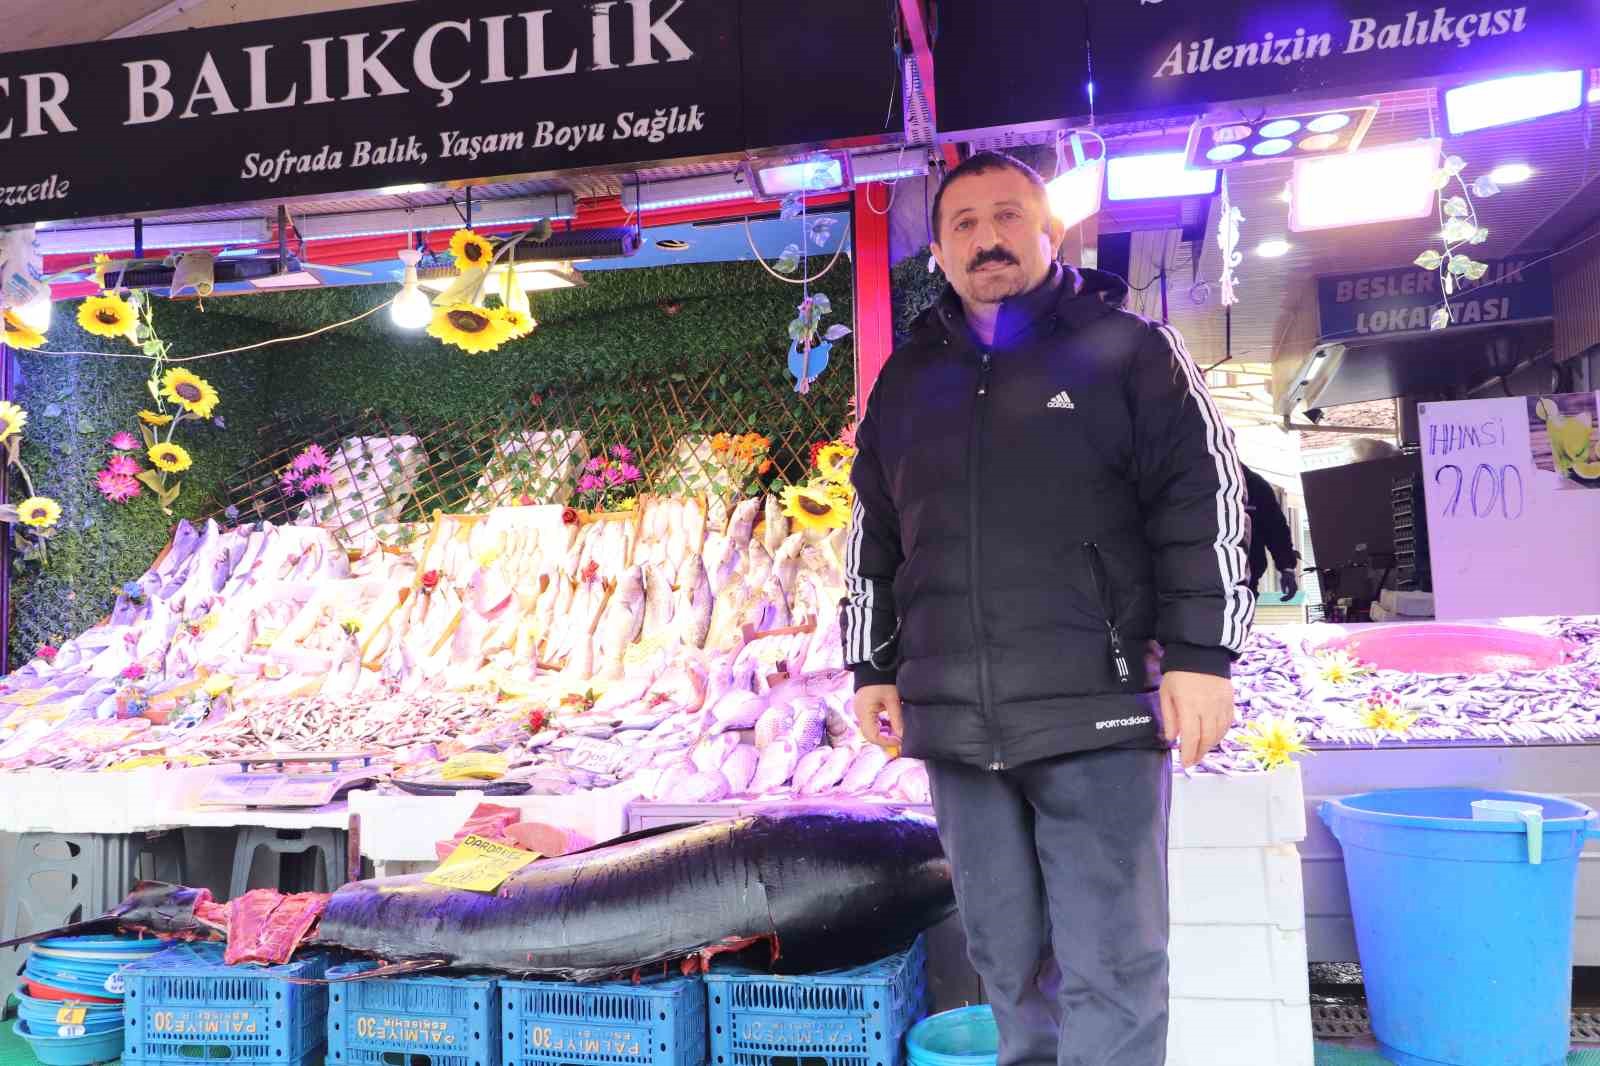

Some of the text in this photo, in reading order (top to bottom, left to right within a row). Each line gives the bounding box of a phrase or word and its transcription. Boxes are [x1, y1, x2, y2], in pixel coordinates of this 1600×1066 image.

[1152, 6, 1527, 79] Ailenizin Balıkçısı
[0, 71, 78, 139] R
[240, 103, 705, 180] Sofrada Balık, Yaşam Boyu Sağlık
[1335, 271, 1435, 302] BESLER
[1356, 297, 1510, 334] LOKATASI
[1047, 401, 1075, 409] adidas
